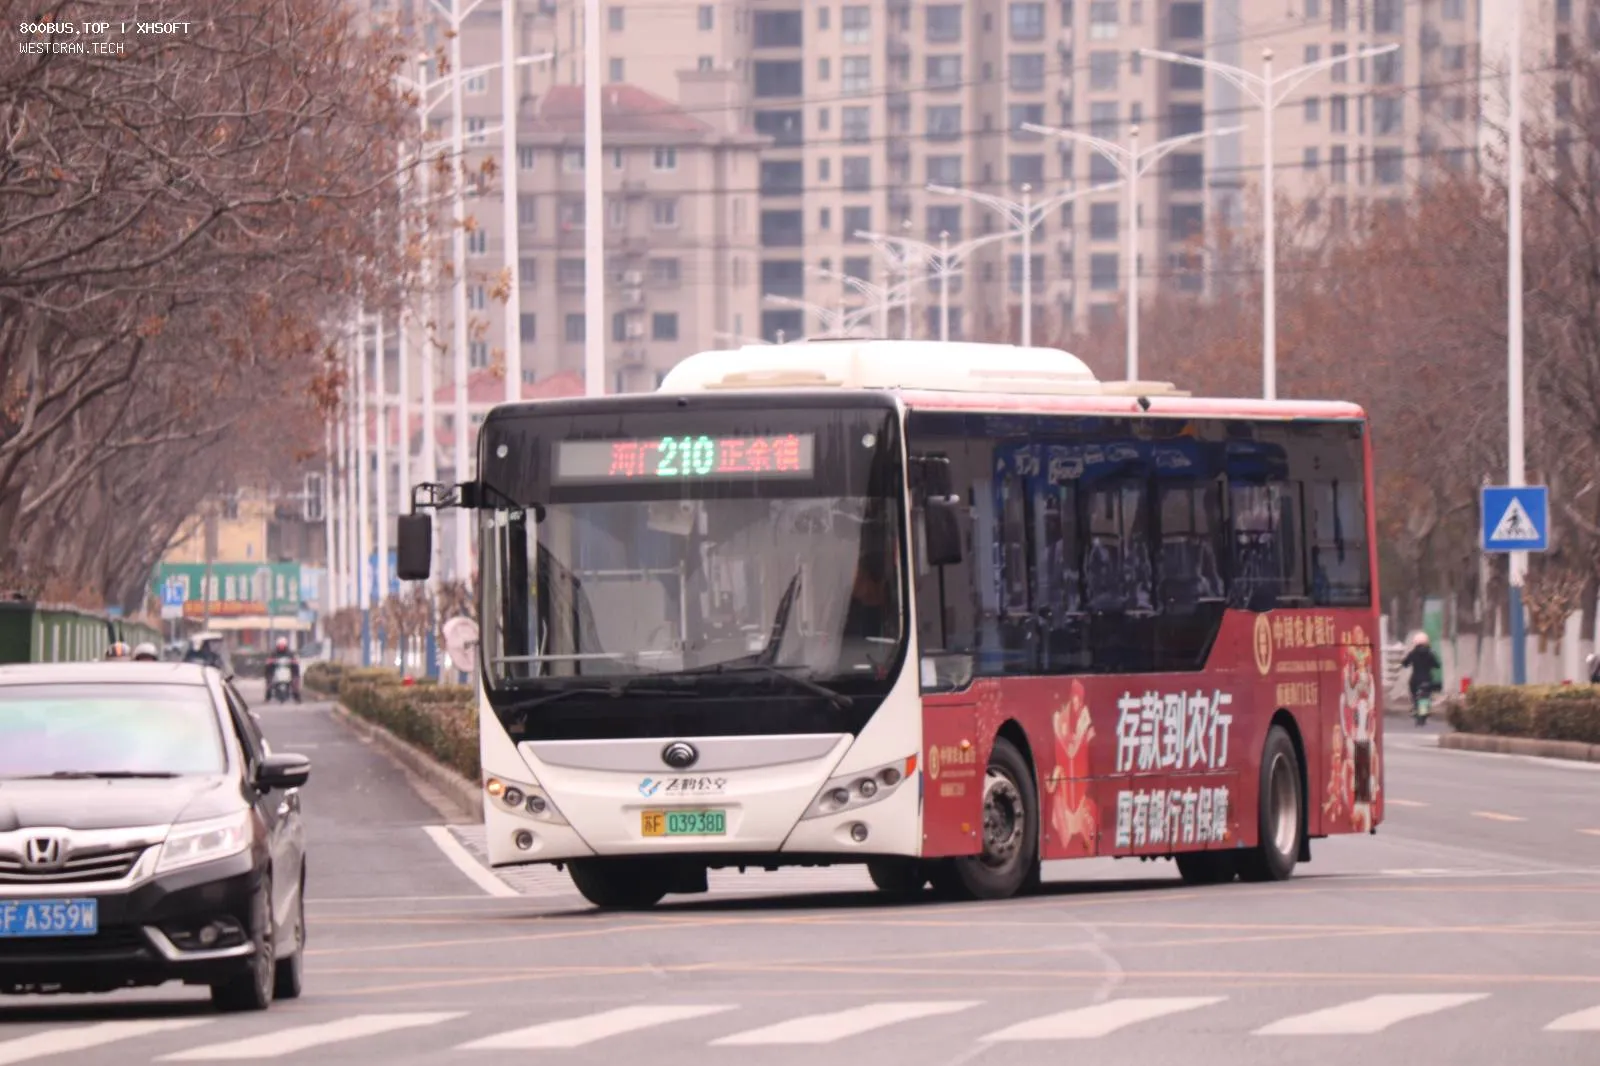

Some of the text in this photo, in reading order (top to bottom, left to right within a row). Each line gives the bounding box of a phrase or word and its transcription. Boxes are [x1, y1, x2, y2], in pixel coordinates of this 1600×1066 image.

[656, 436, 715, 477] 210
[1273, 616, 1336, 649] 中国农业银行
[1116, 688, 1233, 772] 存款到农行
[669, 814, 725, 832] 03938D
[1115, 785, 1229, 848] 国有银行有保障
